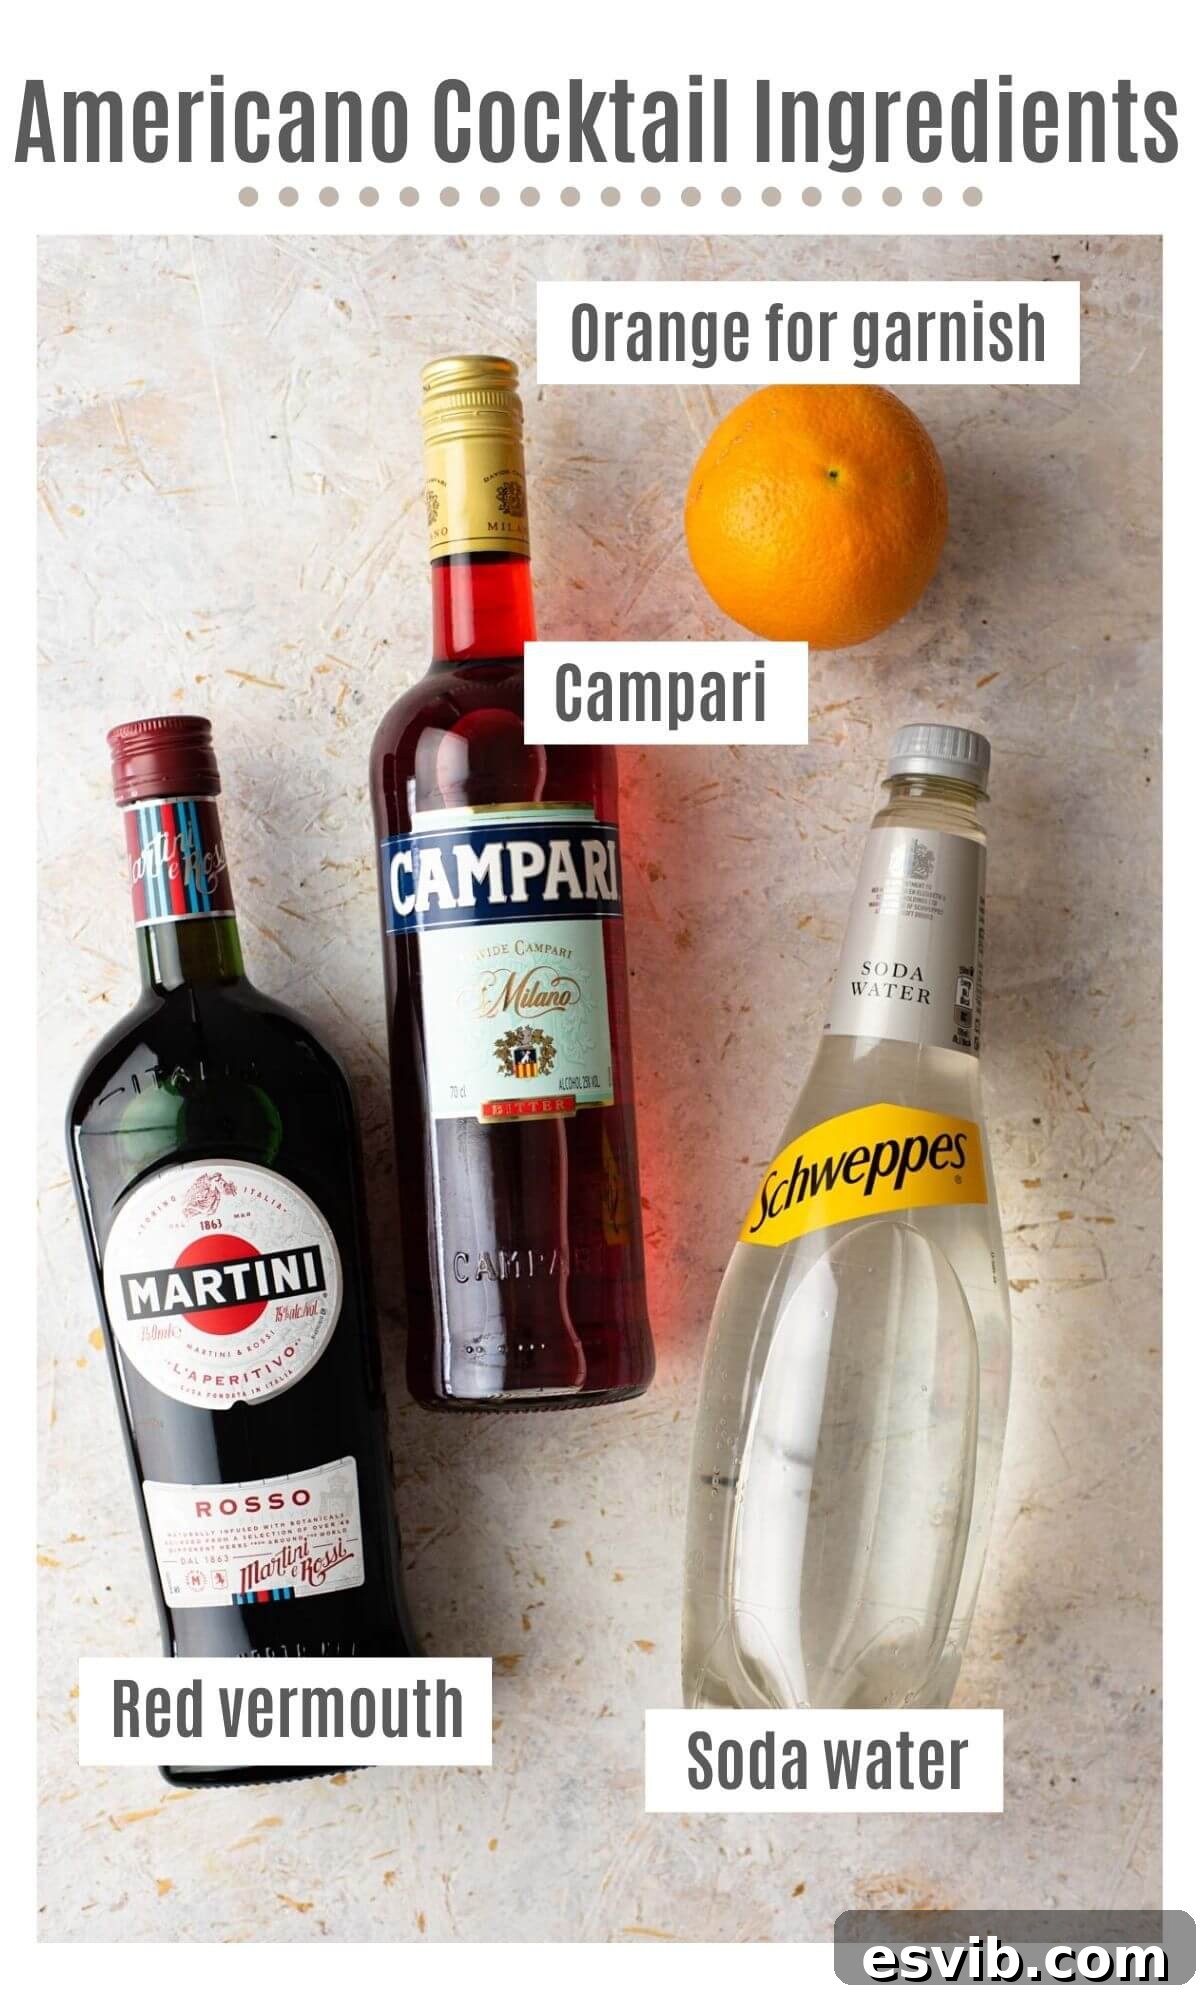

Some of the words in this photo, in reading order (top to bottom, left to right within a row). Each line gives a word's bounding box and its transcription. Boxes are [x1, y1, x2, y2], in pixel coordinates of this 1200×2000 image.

[390, 839, 619, 917] CAMPARI
[488, 965, 581, 1019] Milano
[850, 980, 932, 1006] WATER
[860, 960, 925, 983] SODA
[492, 1099, 566, 1117] BITTER
[749, 1132, 968, 1234] Schweppes
[199, 1218, 223, 1232] 1863
[127, 1252, 318, 1316] MARTINI
[195, 1489, 311, 1518] ROSSO
[240, 1536, 309, 1594] Martini
[300, 1537, 354, 1587] Rossi
